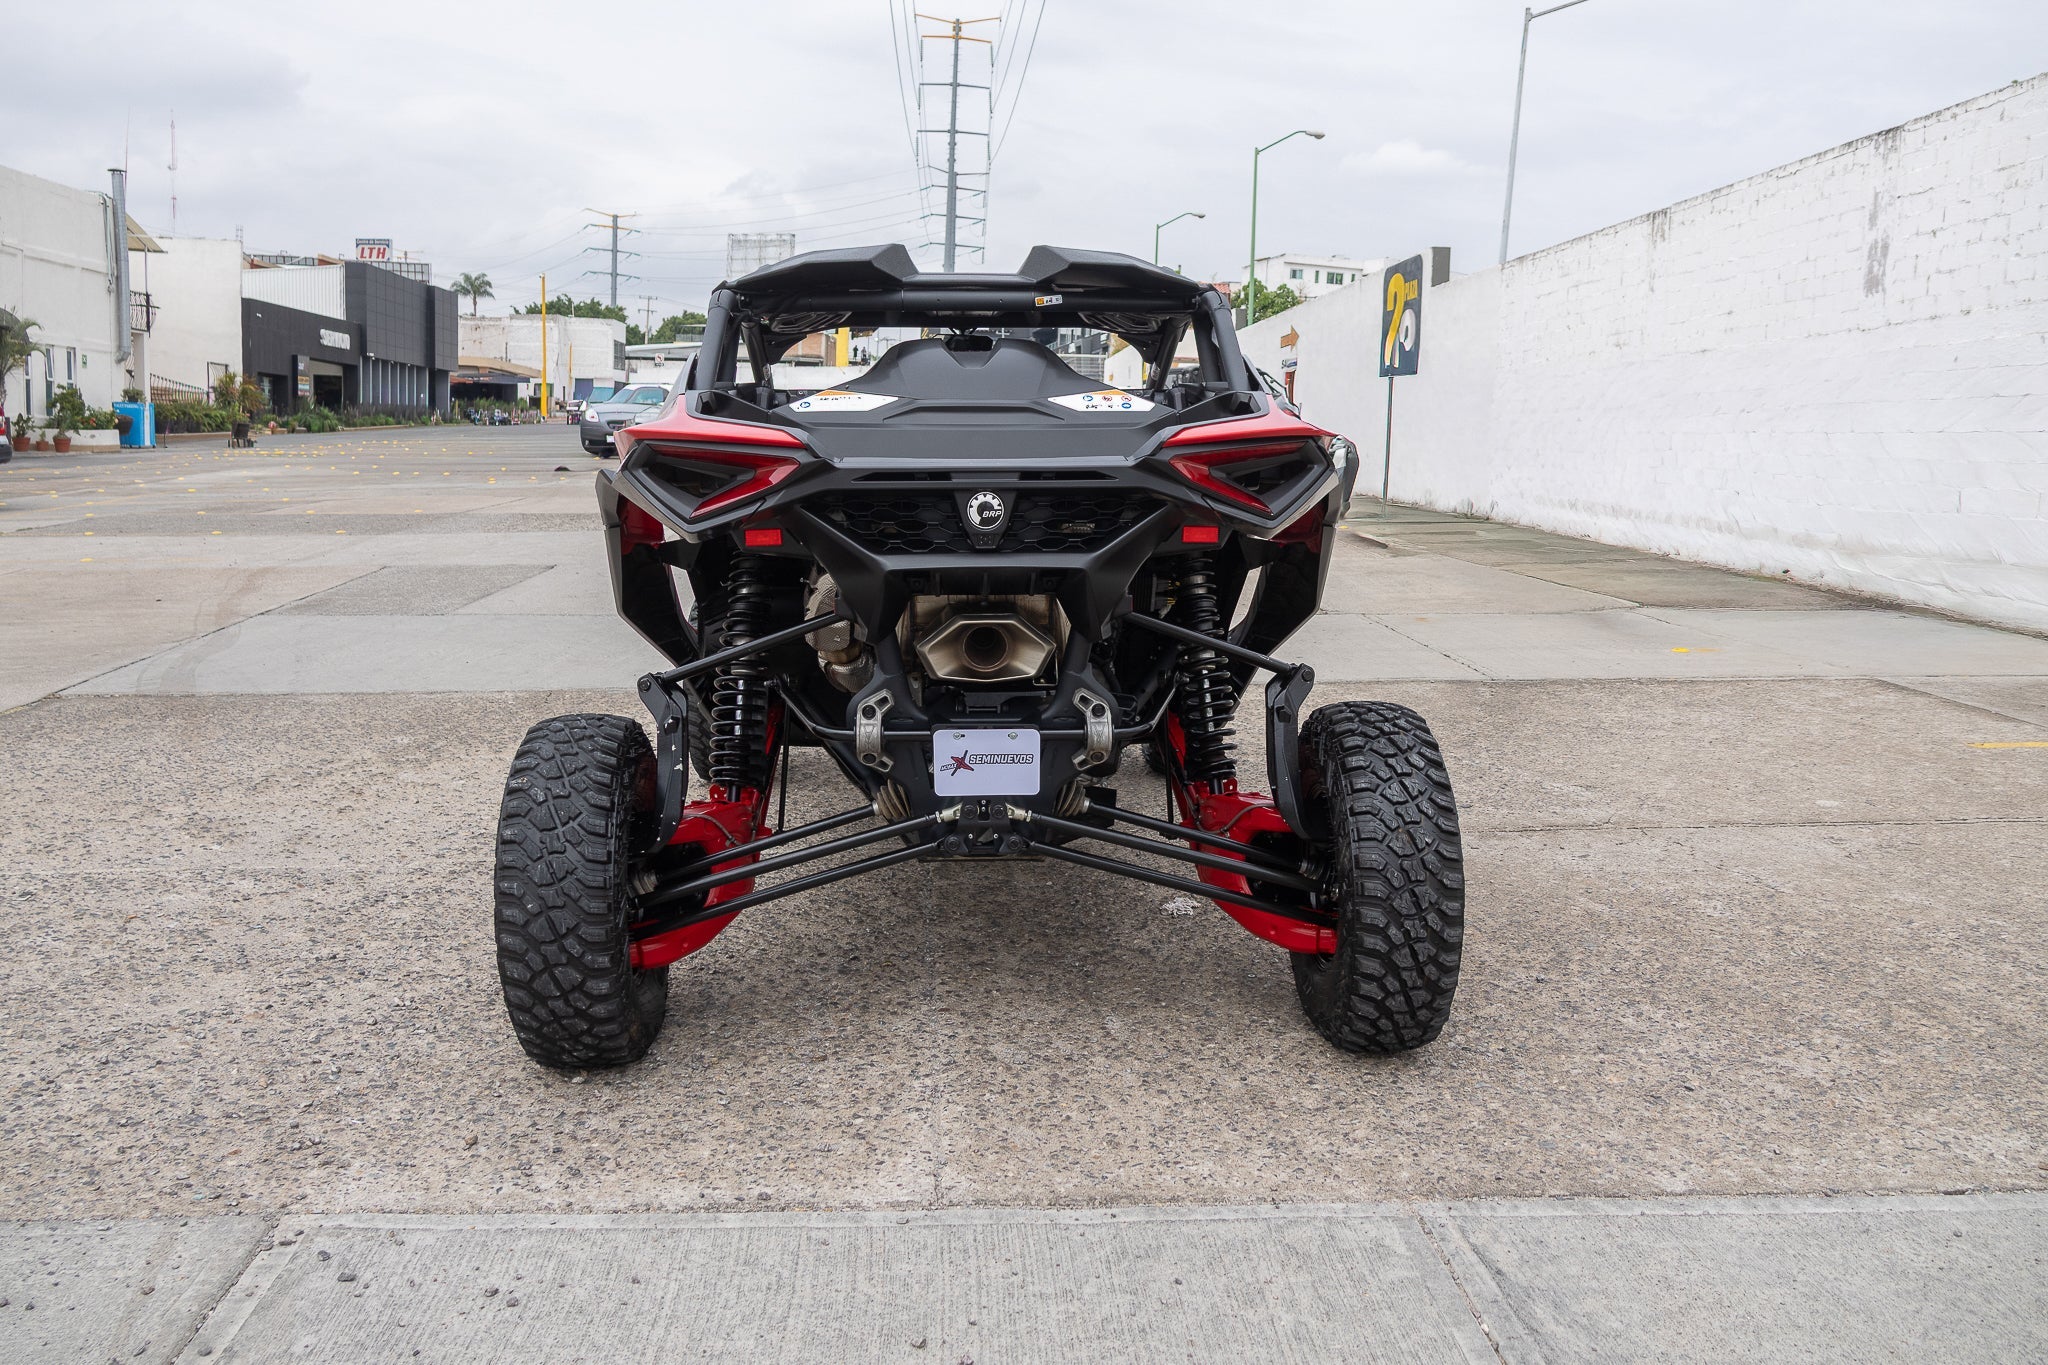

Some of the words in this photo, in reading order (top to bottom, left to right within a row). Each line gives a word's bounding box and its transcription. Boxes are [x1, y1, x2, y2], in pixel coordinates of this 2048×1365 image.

[360, 247, 387, 259] LTH
[1404, 279, 1418, 301] PLAZA
[982, 510, 1002, 518] BRP
[968, 753, 1035, 764] SEMINUEVOS
